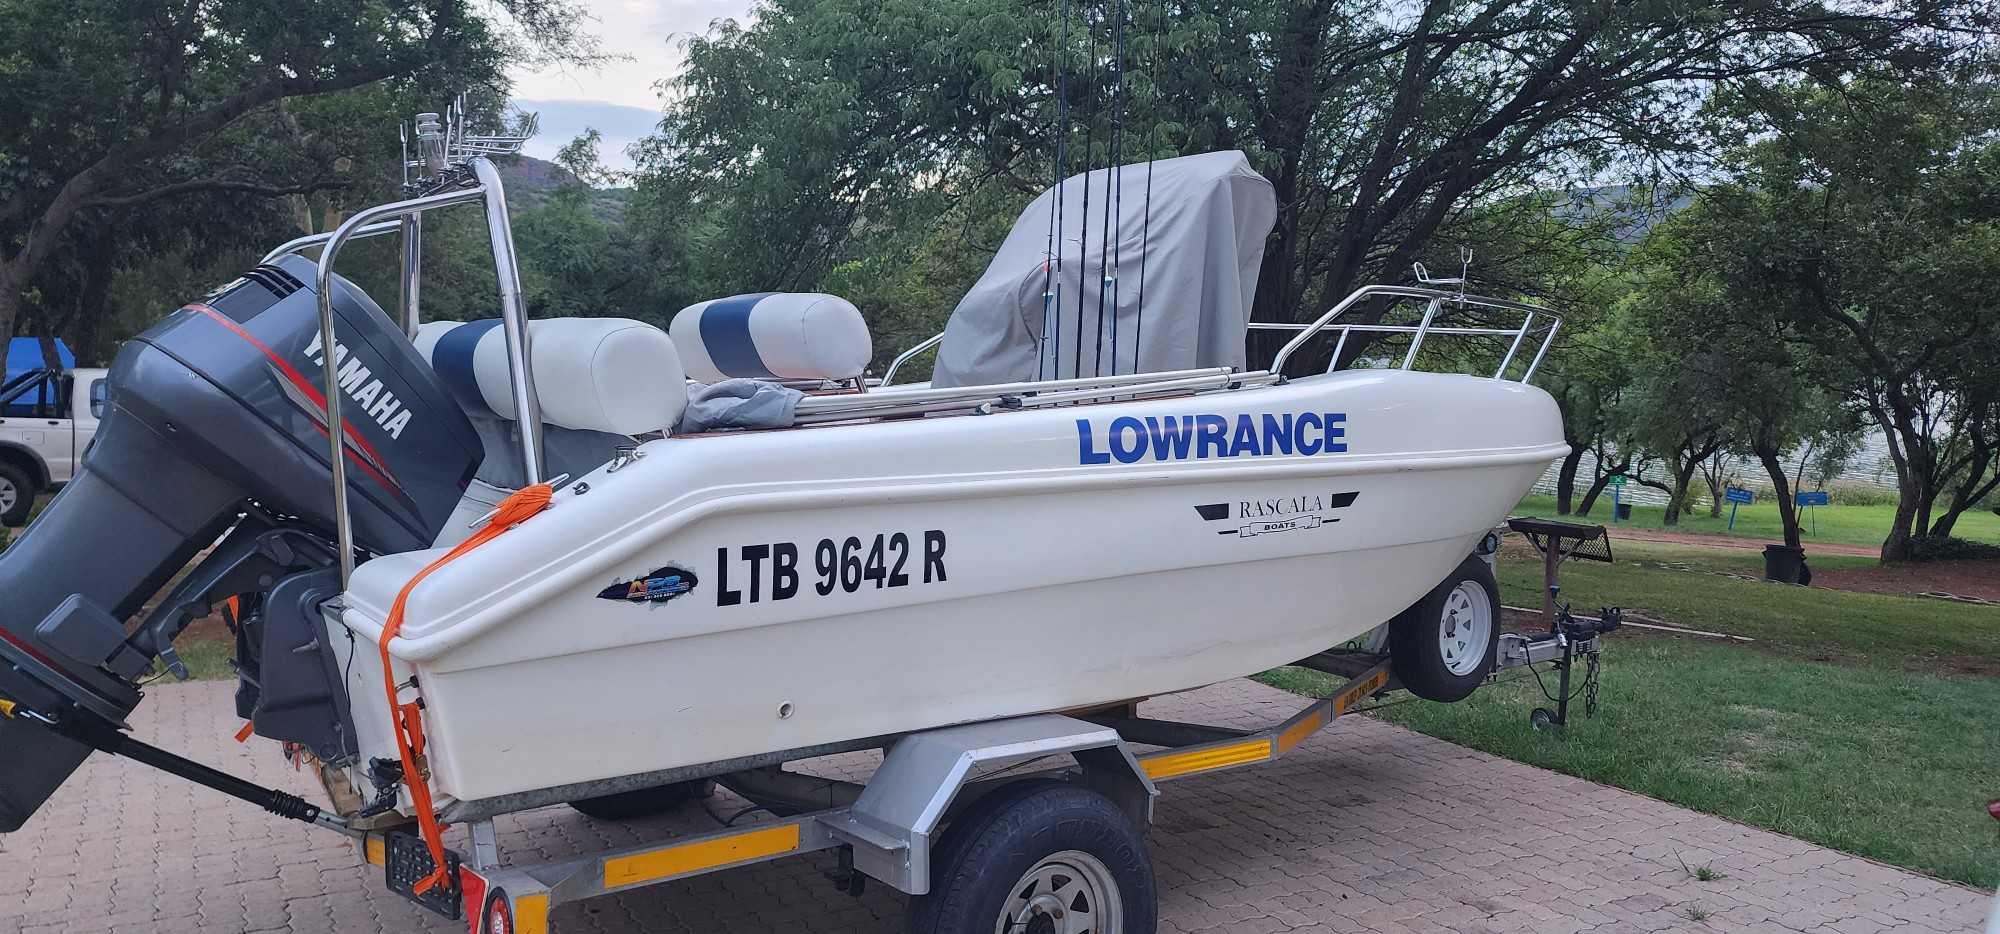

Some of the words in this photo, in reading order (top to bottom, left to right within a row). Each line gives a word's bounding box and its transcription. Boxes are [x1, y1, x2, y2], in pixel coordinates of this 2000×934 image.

[1076, 412, 1347, 465] LOWRANCE
[1240, 495, 1322, 518] RASCALA
[1264, 522, 1296, 530] BOATS
[717, 542, 799, 606] LTB
[815, 532, 909, 596] 9642
[923, 530, 947, 583] R
